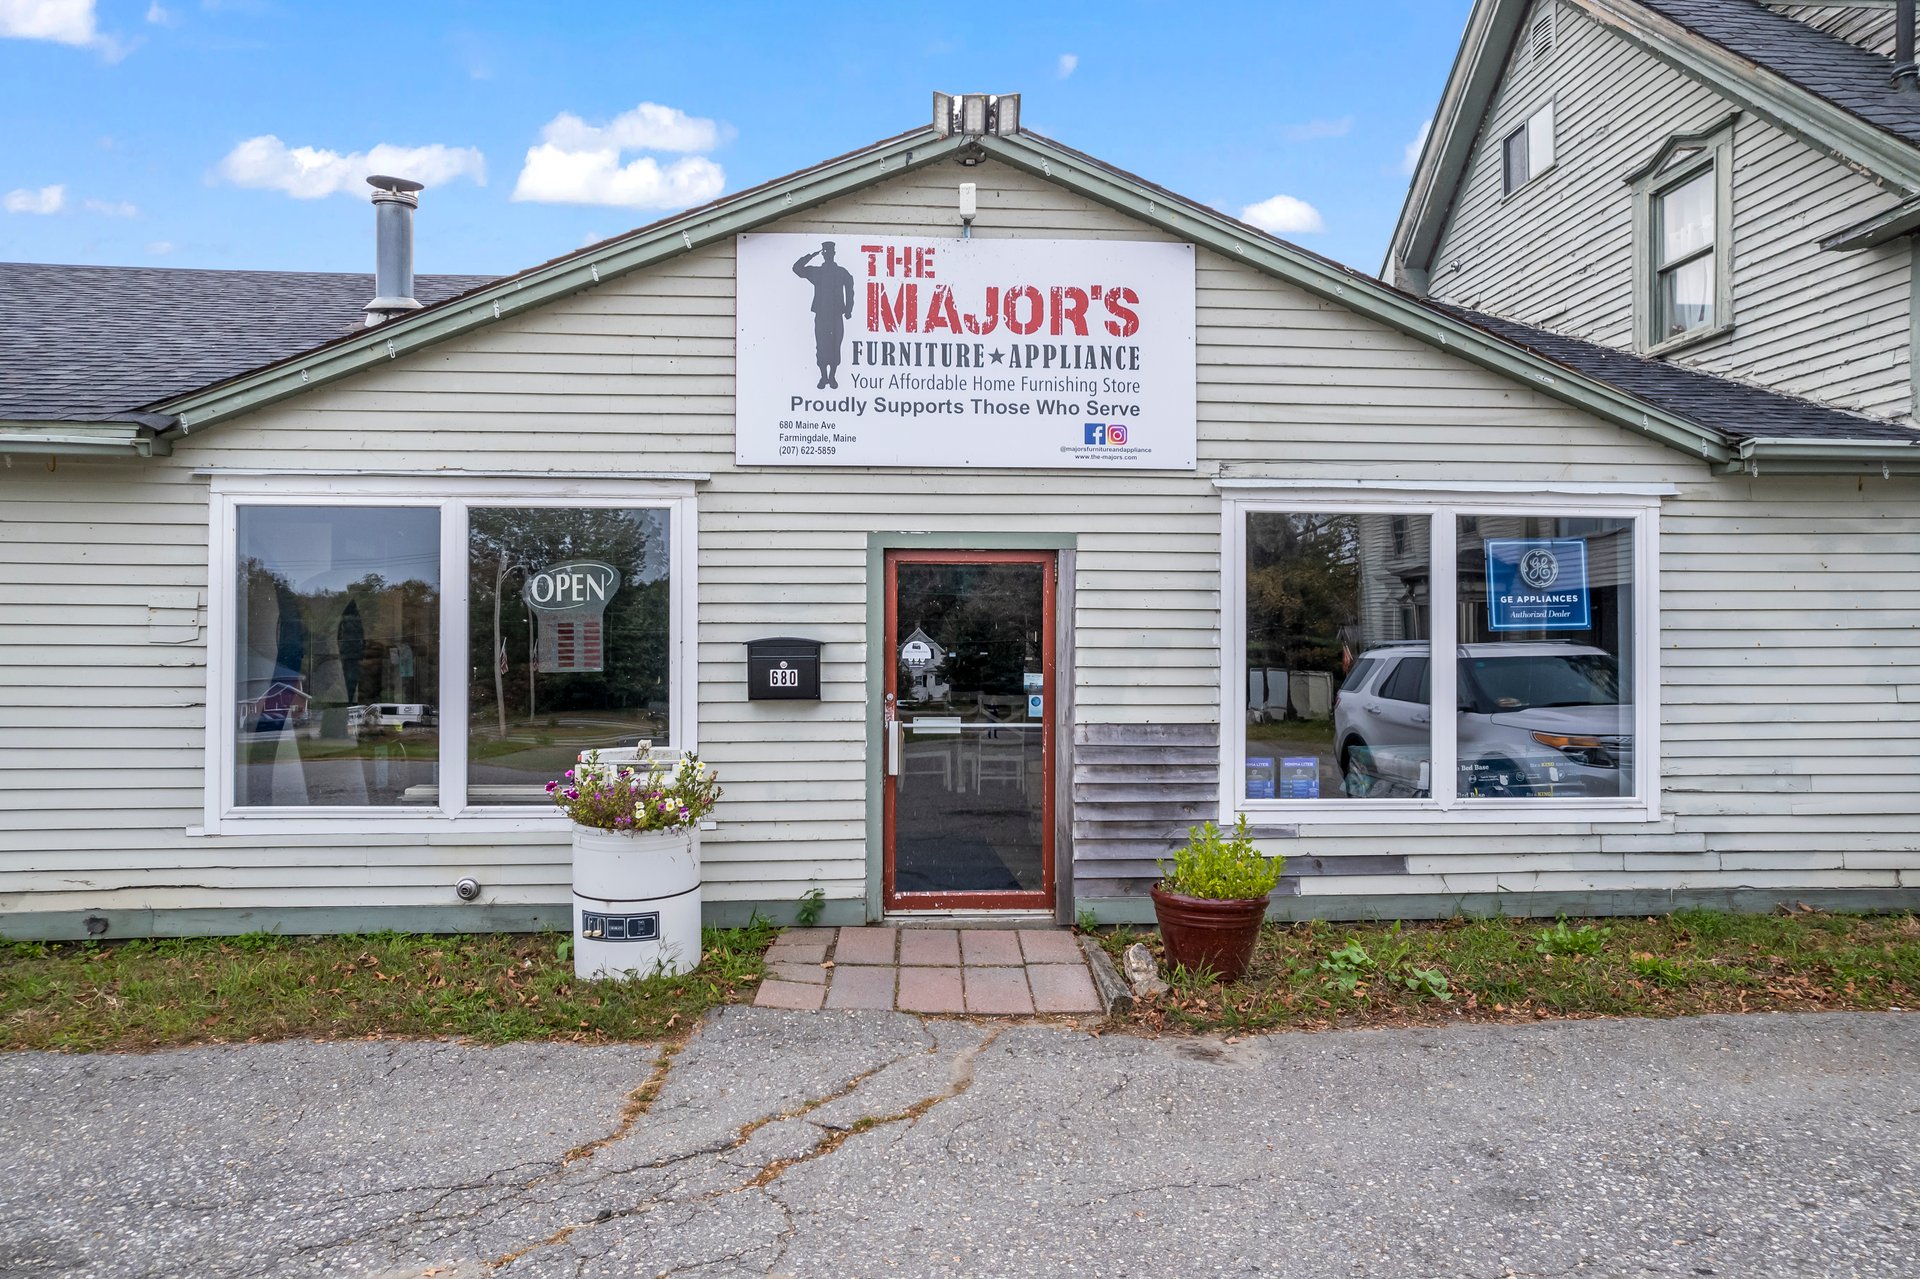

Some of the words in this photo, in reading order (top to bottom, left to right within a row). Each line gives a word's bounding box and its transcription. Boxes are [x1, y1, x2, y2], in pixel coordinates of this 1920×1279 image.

[861, 245, 935, 279] THE
[866, 281, 1140, 337] MAJOR'S
[852, 341, 985, 368] FURNITURE
[1009, 345, 1140, 370] APPLIANCE
[851, 373, 884, 389] Your
[888, 373, 967, 391] Affordable
[973, 376, 1016, 391] Home
[1021, 376, 1097, 396] Furnishing
[1103, 378, 1140, 393] Store
[791, 396, 867, 415] Proudly
[874, 397, 964, 417] Supports
[971, 399, 1030, 415] Those
[1036, 399, 1080, 415] Who
[1086, 400, 1140, 416] Serve
[779, 420, 794, 429] 680
[795, 420, 819, 430] Maine
[820, 421, 836, 430] Ave
[779, 433, 831, 444] Farmingdale,
[833, 434, 857, 443] Maine
[779, 446, 799, 456] (207)
[800, 446, 836, 455] 622-5859
[531, 573, 605, 602] OPEN
[1517, 595, 1579, 603] APPLIANCES
[1510, 610, 1547, 618] Authorized
[1548, 610, 1571, 618] Dealer
[771, 670, 797, 686] 680
